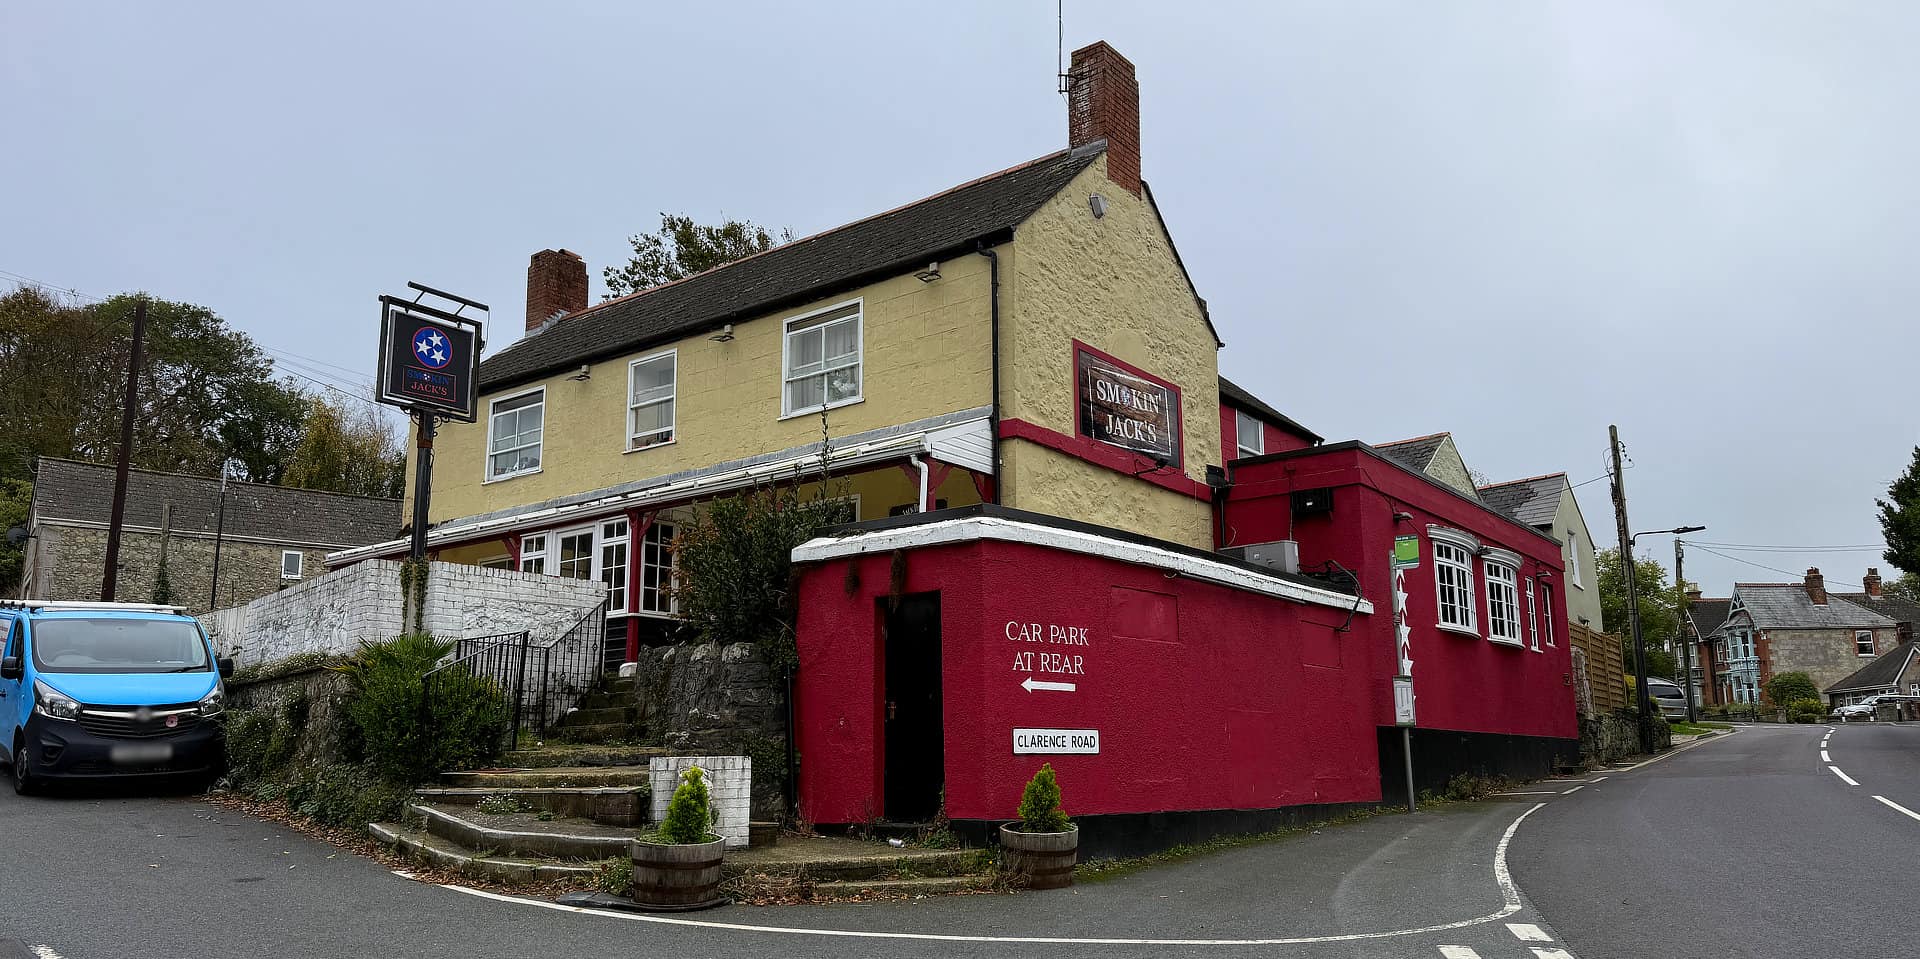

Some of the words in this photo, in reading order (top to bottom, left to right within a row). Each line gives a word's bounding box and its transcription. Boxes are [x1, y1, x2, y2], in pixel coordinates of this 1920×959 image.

[411, 382, 448, 396] JACK'S
[1105, 414, 1157, 443] JACK'S
[1005, 621, 1043, 642] CAR
[1049, 624, 1089, 646] PARK
[1012, 651, 1034, 671] AT
[1040, 652, 1084, 674] REAR
[1017, 735, 1067, 748] CLARENCE
[1071, 735, 1096, 748] ROAD
